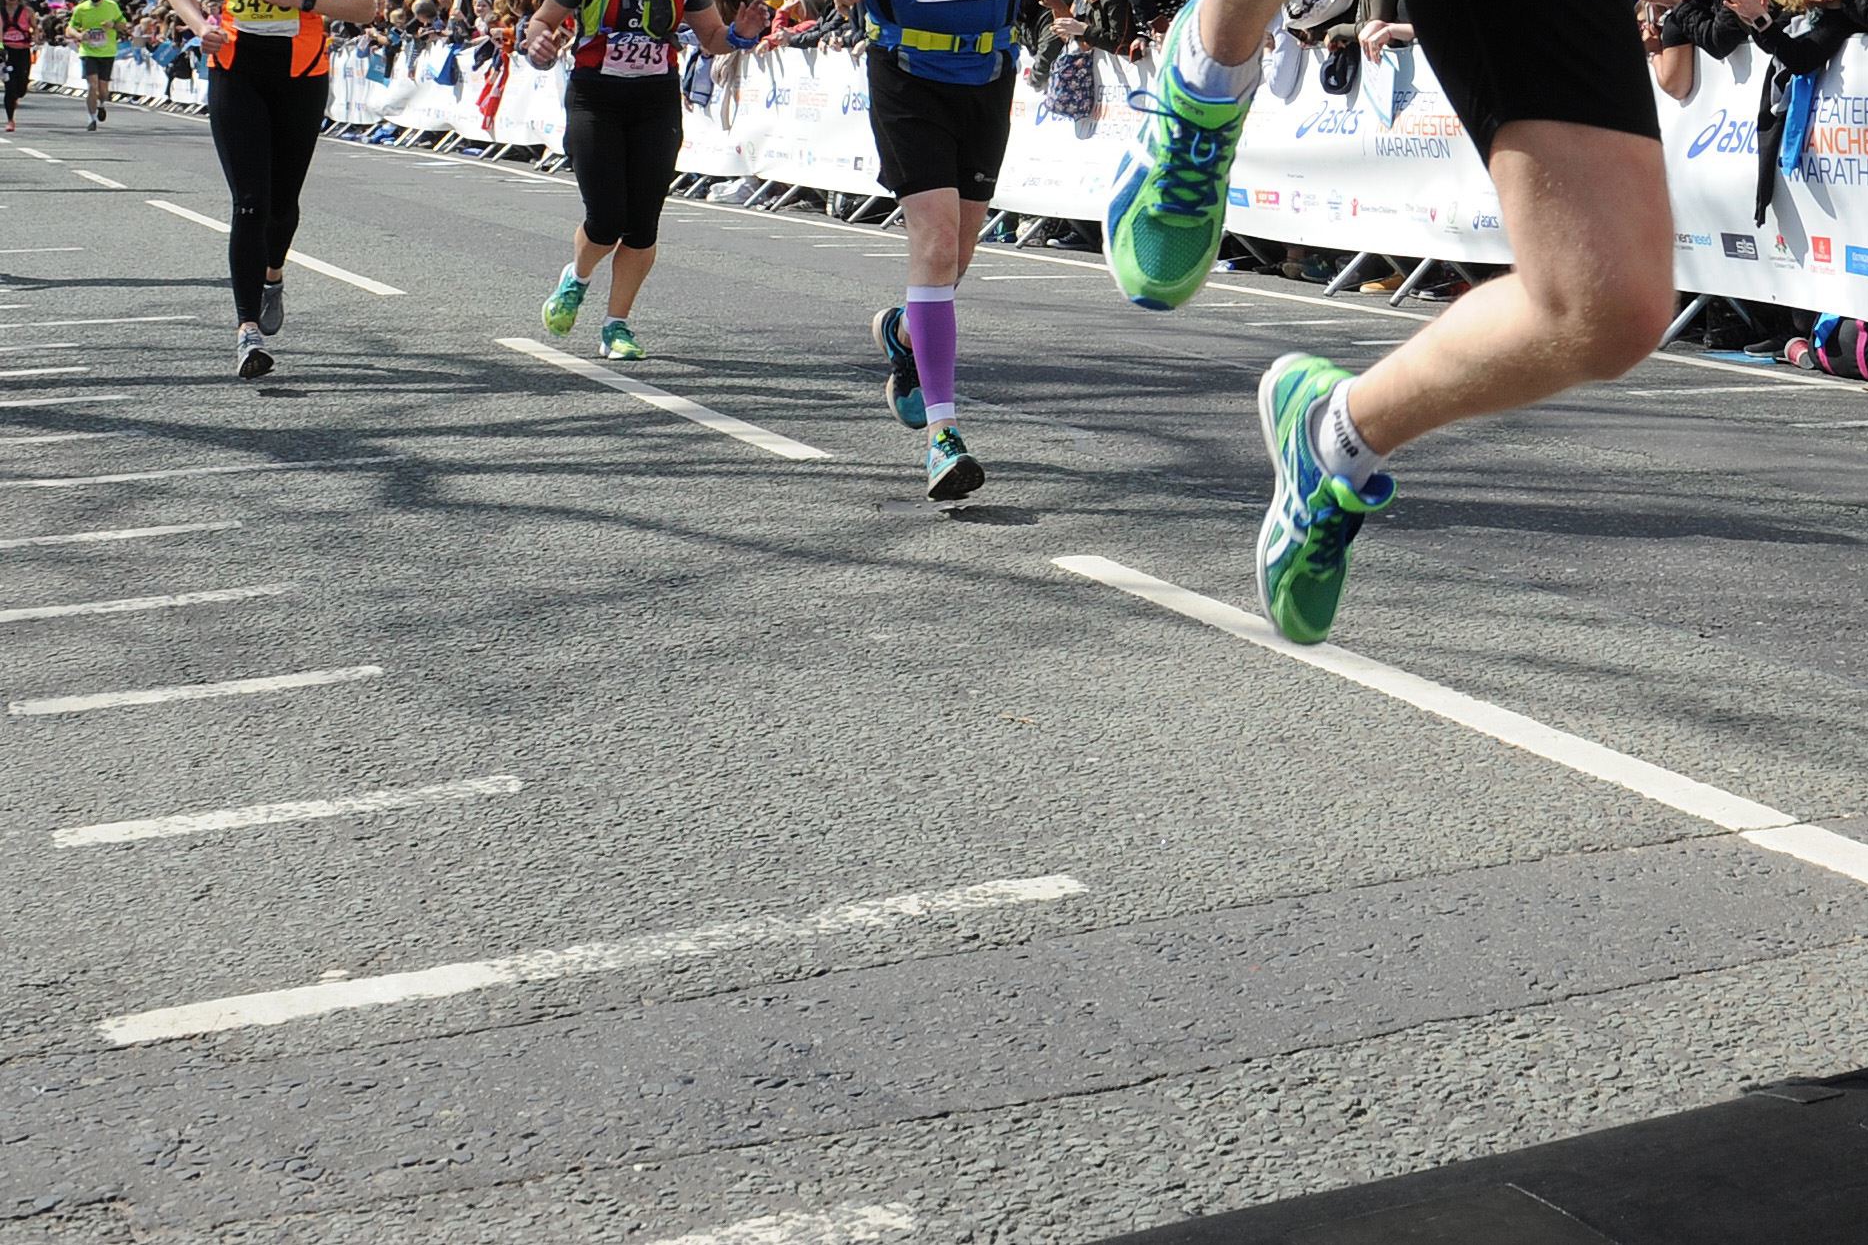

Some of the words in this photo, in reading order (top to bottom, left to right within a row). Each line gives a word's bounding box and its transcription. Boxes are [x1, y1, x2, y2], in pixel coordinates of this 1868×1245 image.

[610, 44, 663, 64] 5243
[1317, 108, 1364, 135] asics
[1375, 136, 1451, 159] MARATHON
[1717, 120, 1759, 154] asic
[1481, 215, 1499, 229] asics
[1334, 409, 1359, 458] PUMA
